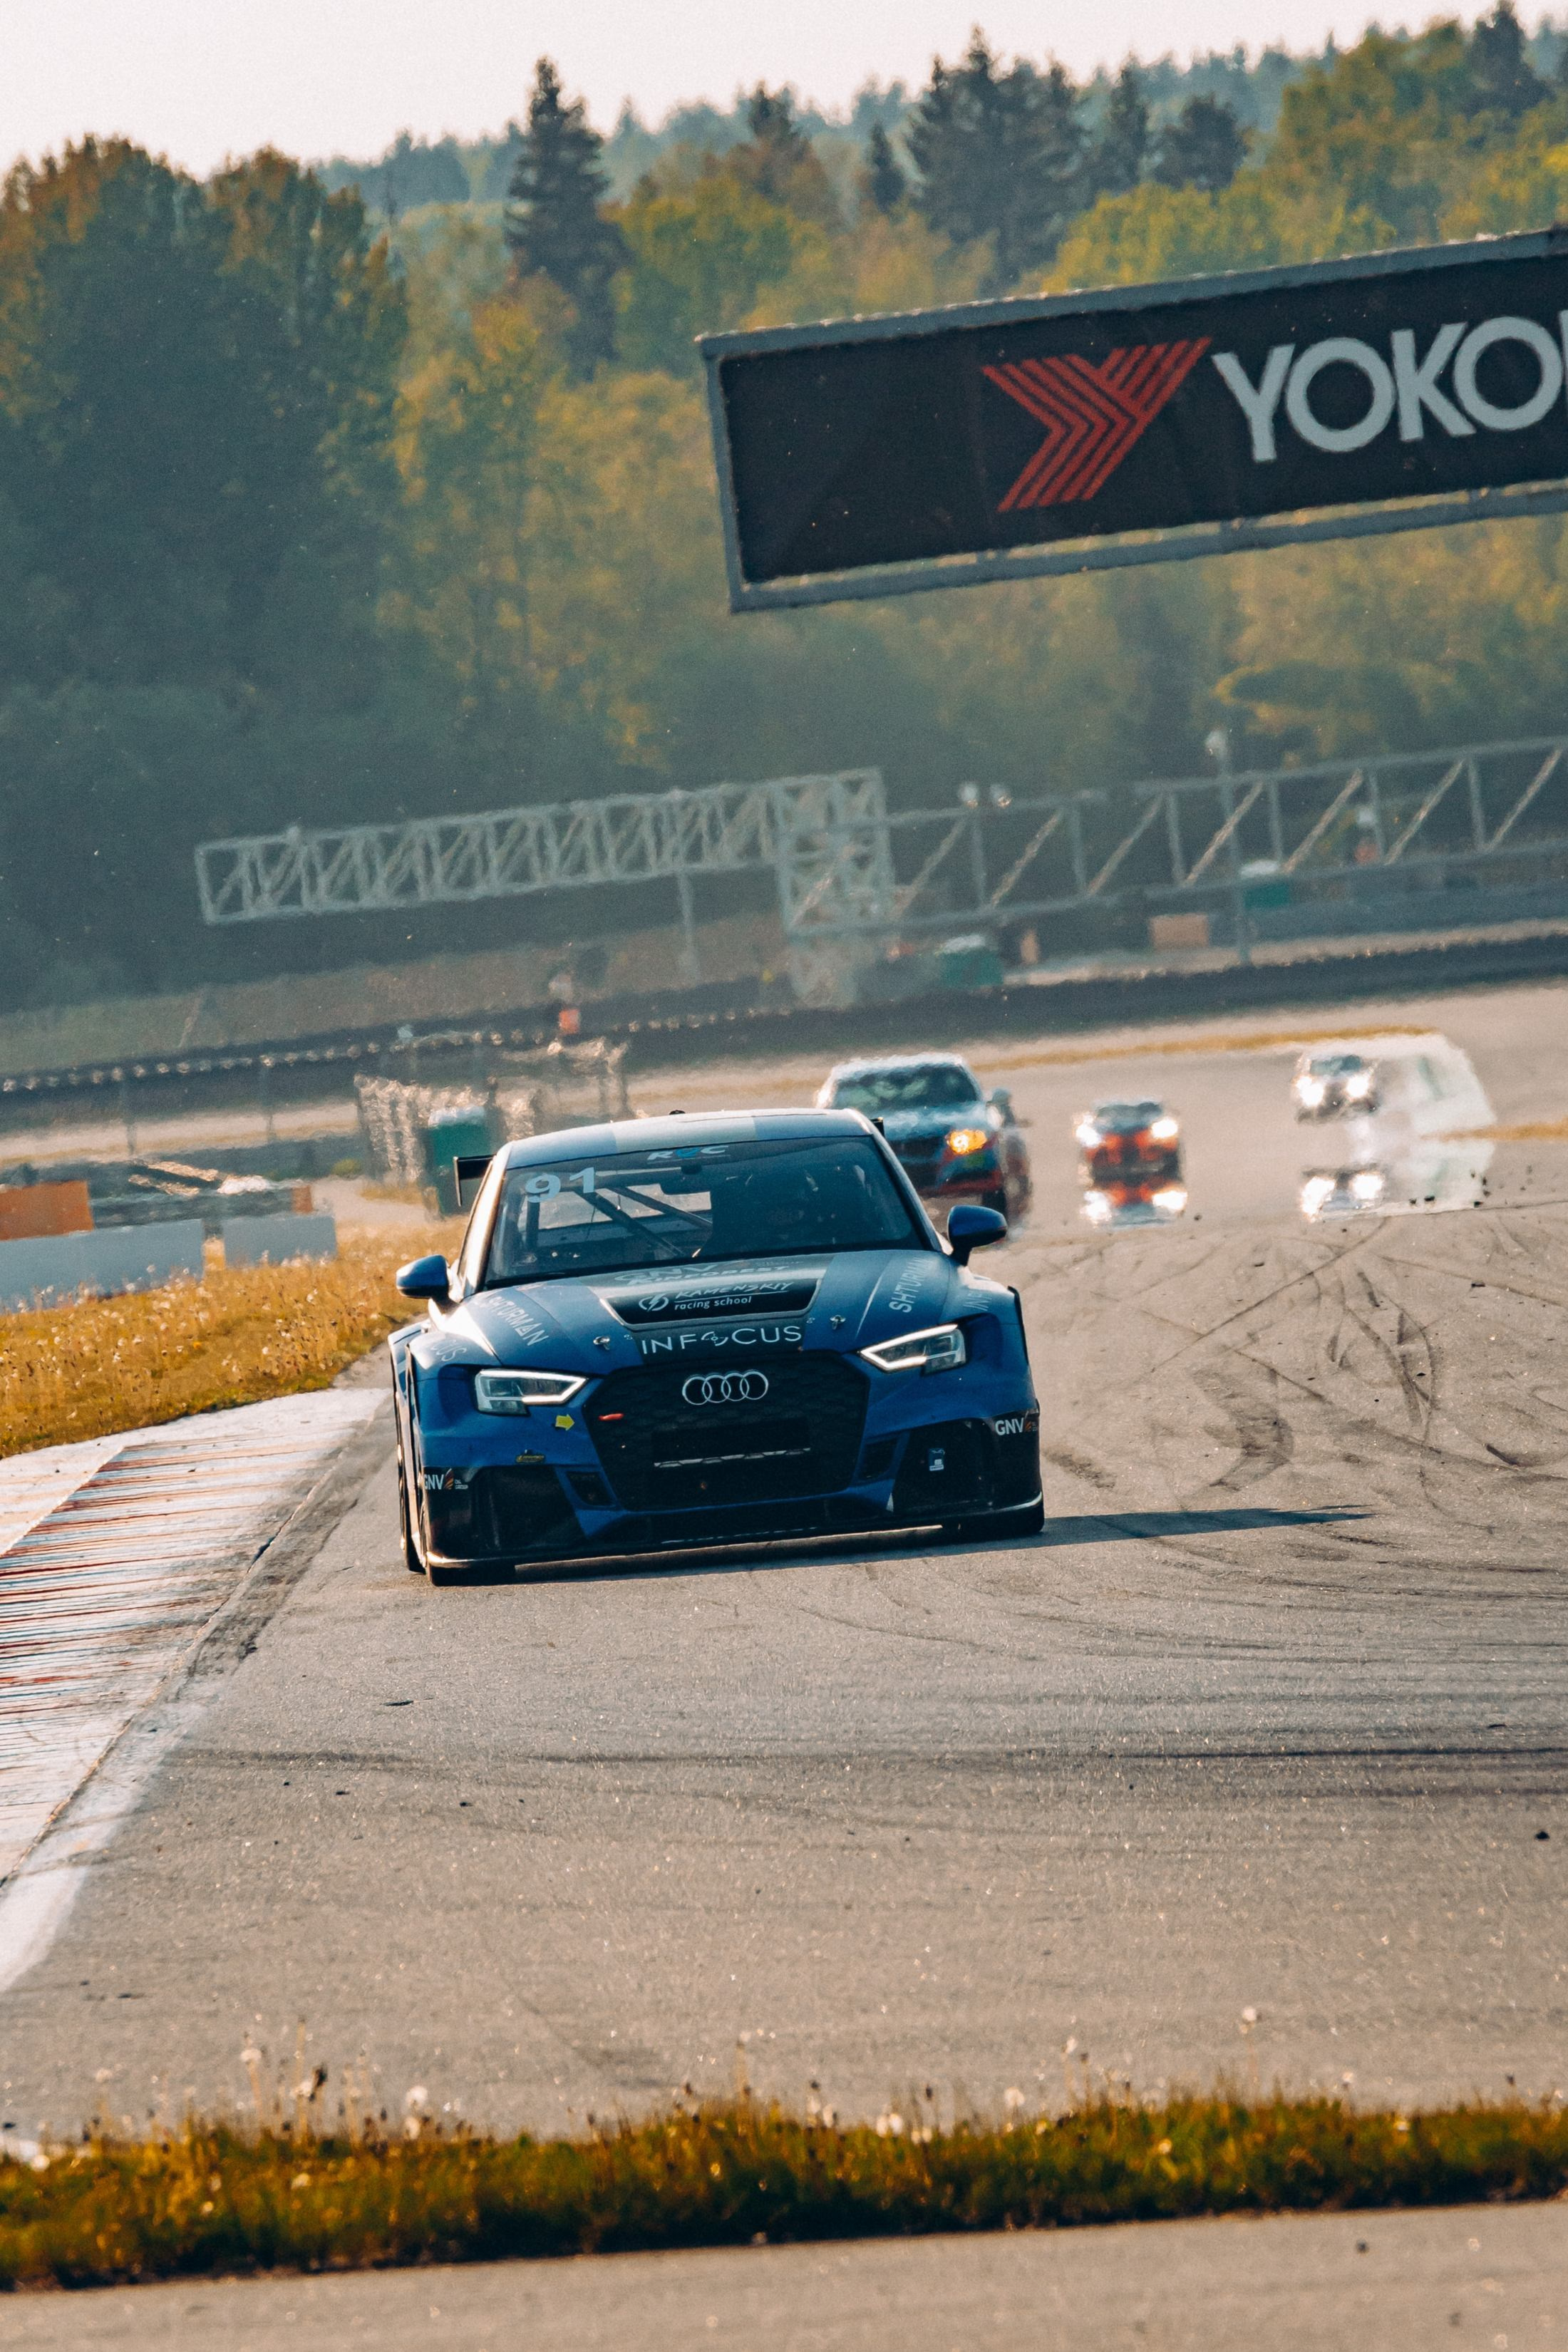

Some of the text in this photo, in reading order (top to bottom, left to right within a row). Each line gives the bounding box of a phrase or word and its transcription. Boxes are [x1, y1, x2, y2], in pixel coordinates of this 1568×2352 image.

[1212, 309, 1568, 463] YOKO
[525, 1167, 594, 1203] 91
[674, 1296, 752, 1310] racing school
[995, 1418, 1025, 1435] GNV
